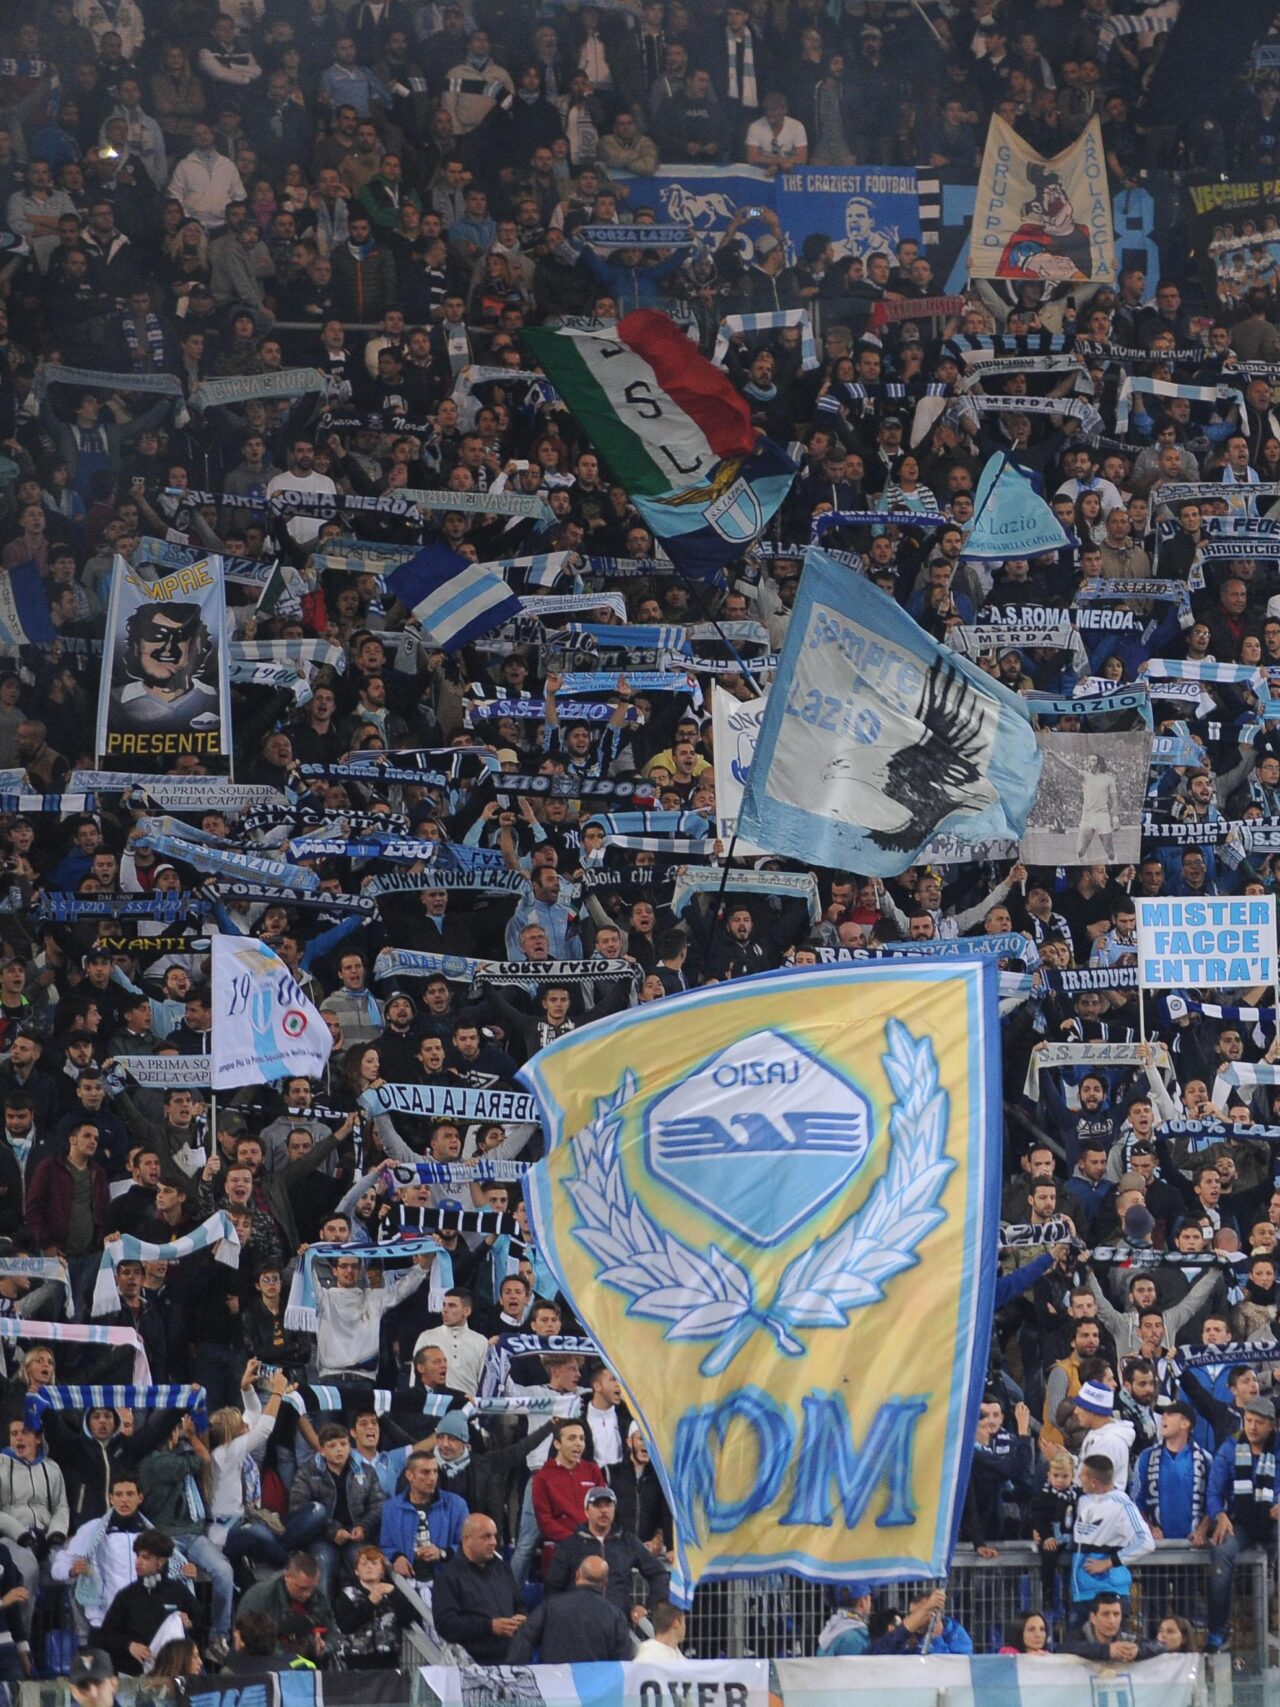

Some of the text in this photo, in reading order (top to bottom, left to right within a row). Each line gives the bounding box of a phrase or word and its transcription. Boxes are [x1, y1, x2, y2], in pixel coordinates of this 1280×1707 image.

[782, 174, 918, 194] THE CRAZIEST FOOTBALL
[984, 146, 1012, 248] GRUPPO
[1189, 184, 1259, 213] VECCHIE
[588, 229, 685, 243] FORZA LAZIO
[1110, 345, 1148, 361] ROMA
[213, 377, 258, 398] CURVA
[276, 369, 318, 390] NORD
[985, 396, 1056, 409] MERDA
[322, 413, 430, 432] Curva Nord
[221, 494, 265, 511] ARE
[271, 492, 337, 514] ROMA
[344, 495, 425, 520] MERDA
[989, 518, 1037, 537] Lazio
[1077, 609, 1135, 635] MERDA
[976, 633, 1054, 645] MERDA
[249, 662, 299, 684] 1900
[496, 700, 532, 717] S.S.
[1052, 696, 1138, 713] LAZIO
[107, 731, 221, 754] PRESENTE
[305, 763, 447, 787] as roma merda
[151, 784, 163, 796] LA
[167, 784, 205, 796] PRIMA
[500, 774, 653, 797] ZIO 1900
[160, 793, 272, 807] DELLA CAPITALE
[1177, 836, 1219, 846] LAZIO
[220, 850, 286, 877] LAZIO
[379, 872, 431, 891] CURVA
[434, 870, 477, 889] NORD
[70, 900, 106, 913] LAZIO
[147, 899, 183, 913] LAZIO
[218, 882, 375, 910] FORZA LAZIO
[1142, 902, 1270, 927] MISTER
[97, 936, 186, 951] AVANTI
[1154, 930, 1260, 955] FACCE
[1144, 957, 1270, 984] ENTRA'!
[1039, 1044, 1156, 1063] S.S. LAZI
[130, 1057, 190, 1071] LA PRIMA
[138, 1071, 212, 1085] DELLA CAPI
[1160, 1116, 1227, 1135] 100%
[506, 1332, 595, 1355] sti caz
[1180, 1338, 1274, 1360] LAZIO
[640, 1680, 749, 1707] OVER
